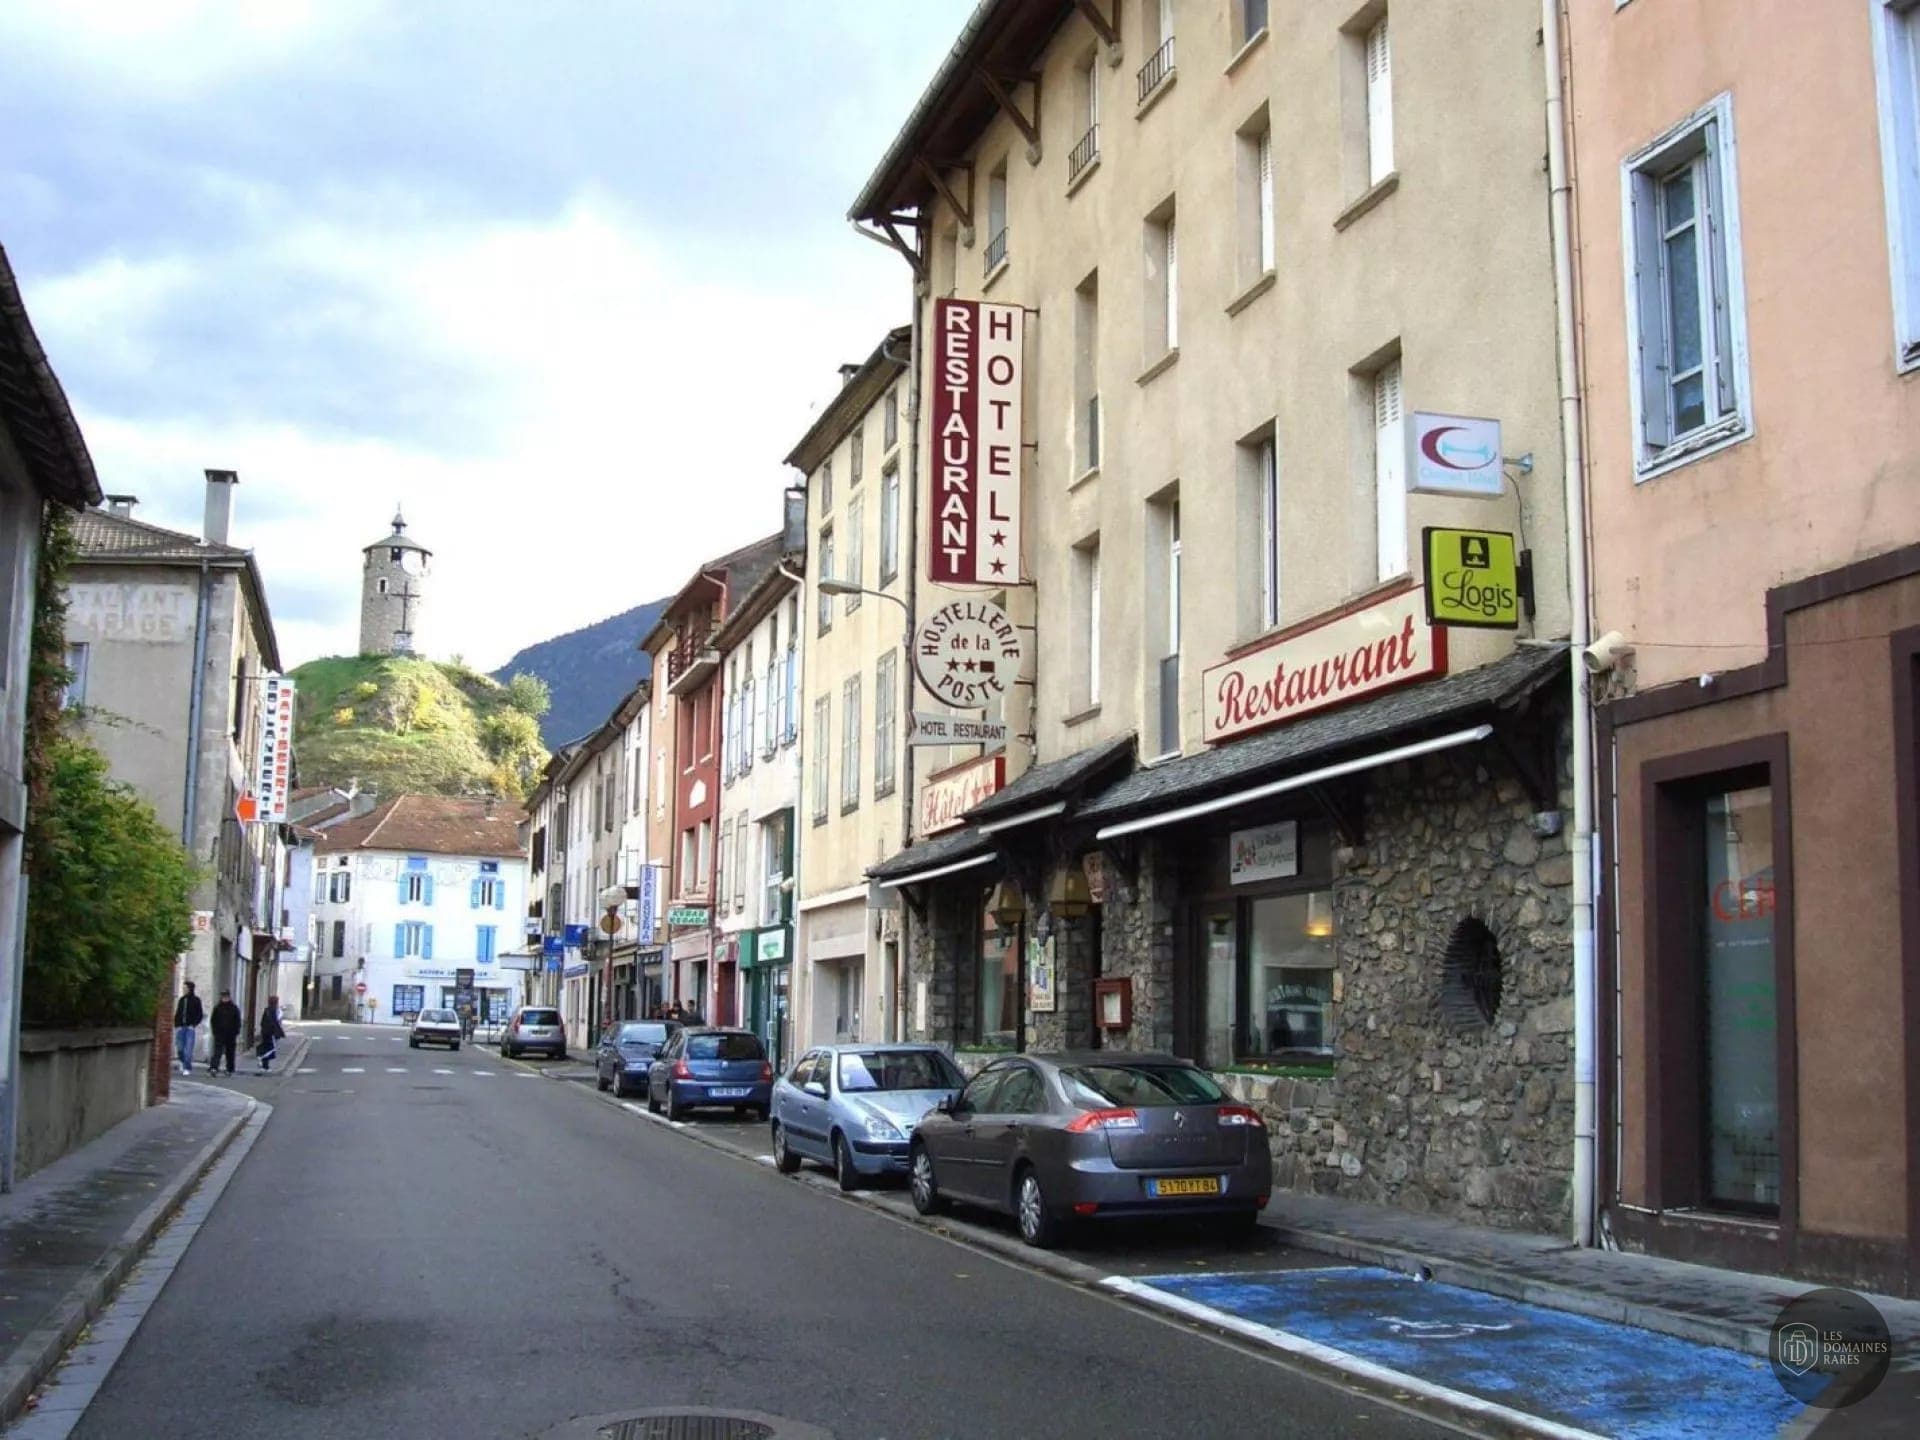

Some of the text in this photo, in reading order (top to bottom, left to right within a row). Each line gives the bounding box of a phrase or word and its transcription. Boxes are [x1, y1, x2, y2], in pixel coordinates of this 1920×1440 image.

[941, 306, 972, 574] RESTAURANT
[987, 311, 1015, 522] HOTEL
[1441, 569, 1513, 616] Logis
[920, 602, 1020, 659] HOSTELLERIE
[951, 633, 990, 650] de la
[938, 674, 1004, 701] POSTE
[1215, 614, 1417, 730] Restaurant
[921, 721, 1007, 740] HOTEL RESTAURANT
[922, 778, 969, 831] Hôtel
